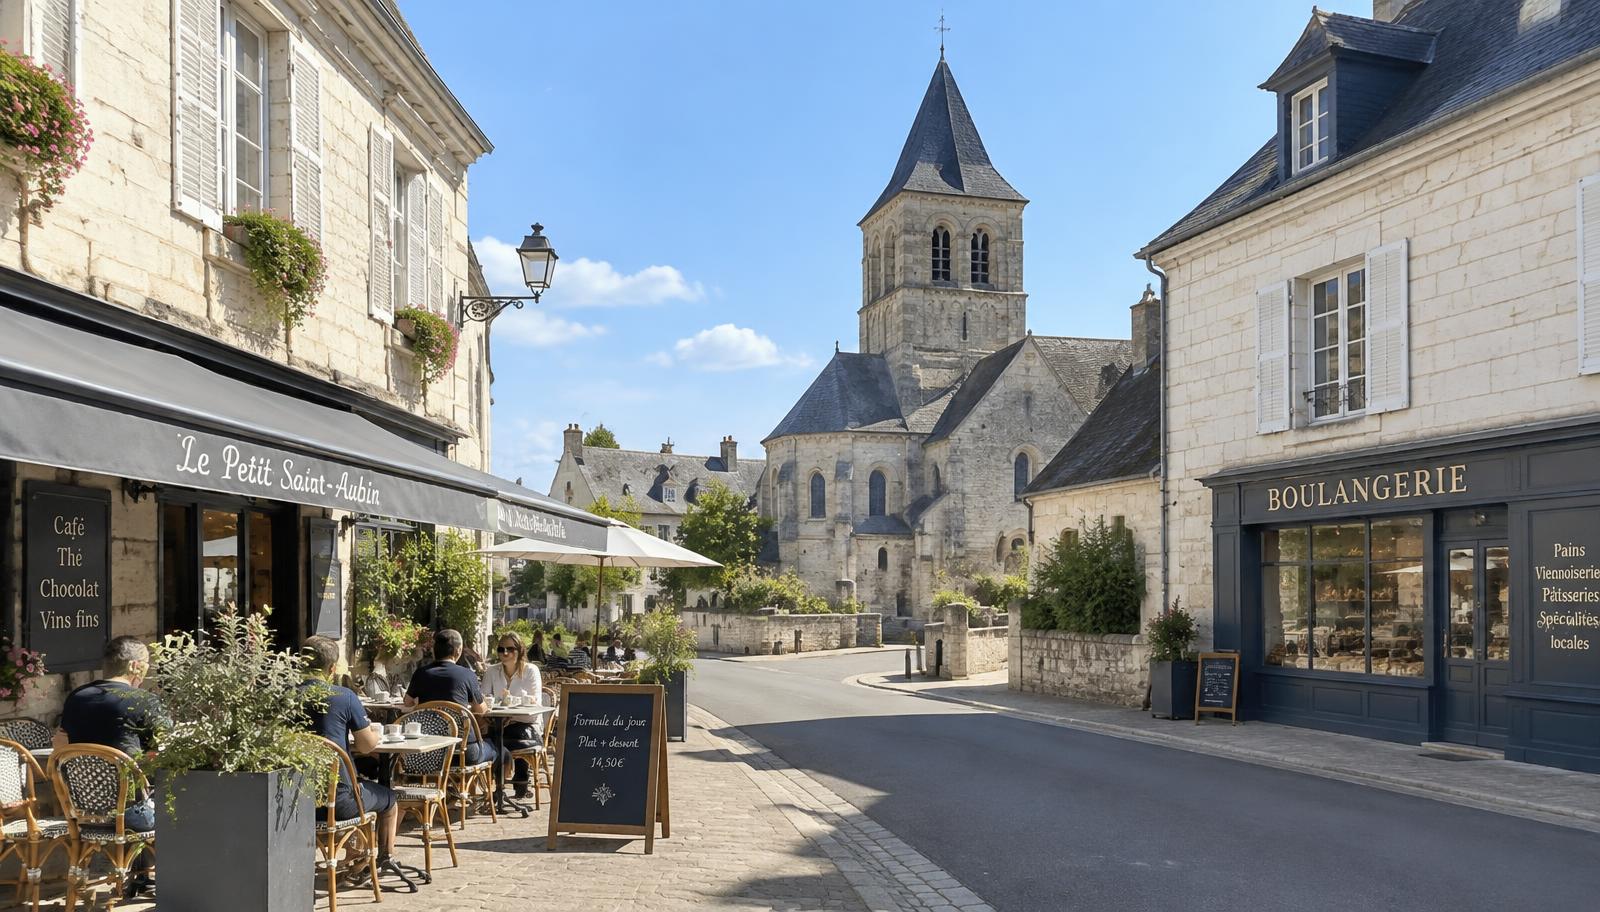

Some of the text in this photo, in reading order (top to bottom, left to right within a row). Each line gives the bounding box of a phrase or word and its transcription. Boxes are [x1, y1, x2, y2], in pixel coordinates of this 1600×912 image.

[176, 435, 210, 475] Le
[221, 444, 273, 487] Petit
[1268, 464, 1467, 511] BOULANGERIE
[54, 515, 85, 537] Café
[57, 547, 83, 567] Thé
[1554, 542, 1586, 558] Pains
[40, 578, 99, 598] Chocolat
[40, 609, 99, 630] Vins fins
[1551, 635, 1590, 650] locales
[573, 713, 610, 727] Formule
[612, 714, 625, 727] du
[578, 735, 598, 748] Plat
[591, 757, 625, 770] 14,50€
